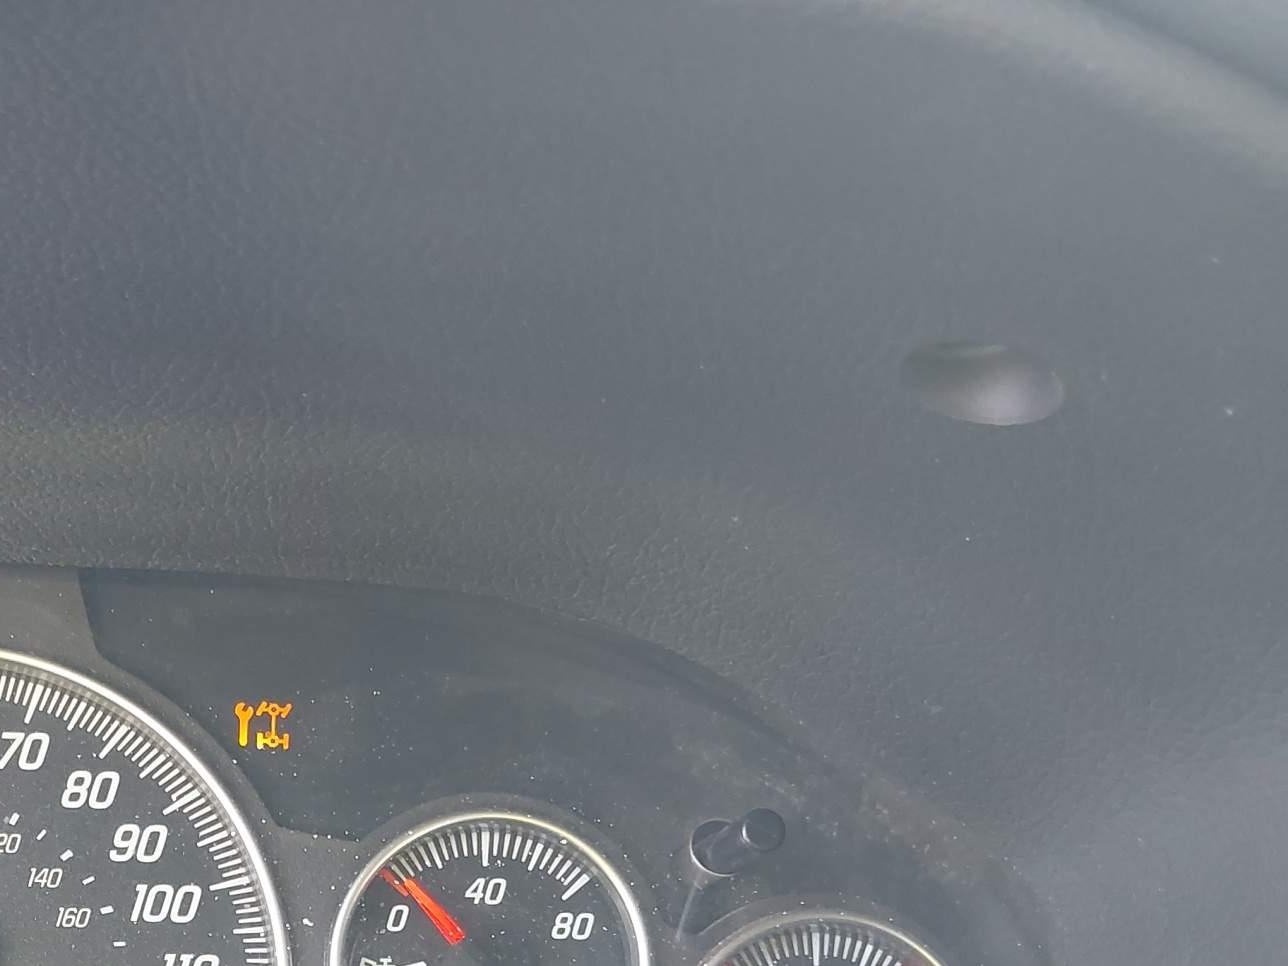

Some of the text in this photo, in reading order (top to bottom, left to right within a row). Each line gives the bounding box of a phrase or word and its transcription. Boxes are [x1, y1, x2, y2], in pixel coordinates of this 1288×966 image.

[61, 770, 120, 810] 80
[109, 823, 168, 863] 90
[27, 867, 63, 889] 140
[464, 877, 507, 905] 40
[55, 906, 92, 928] 160
[130, 882, 202, 924] 100
[386, 904, 410, 932] 0
[551, 912, 595, 941] 80
